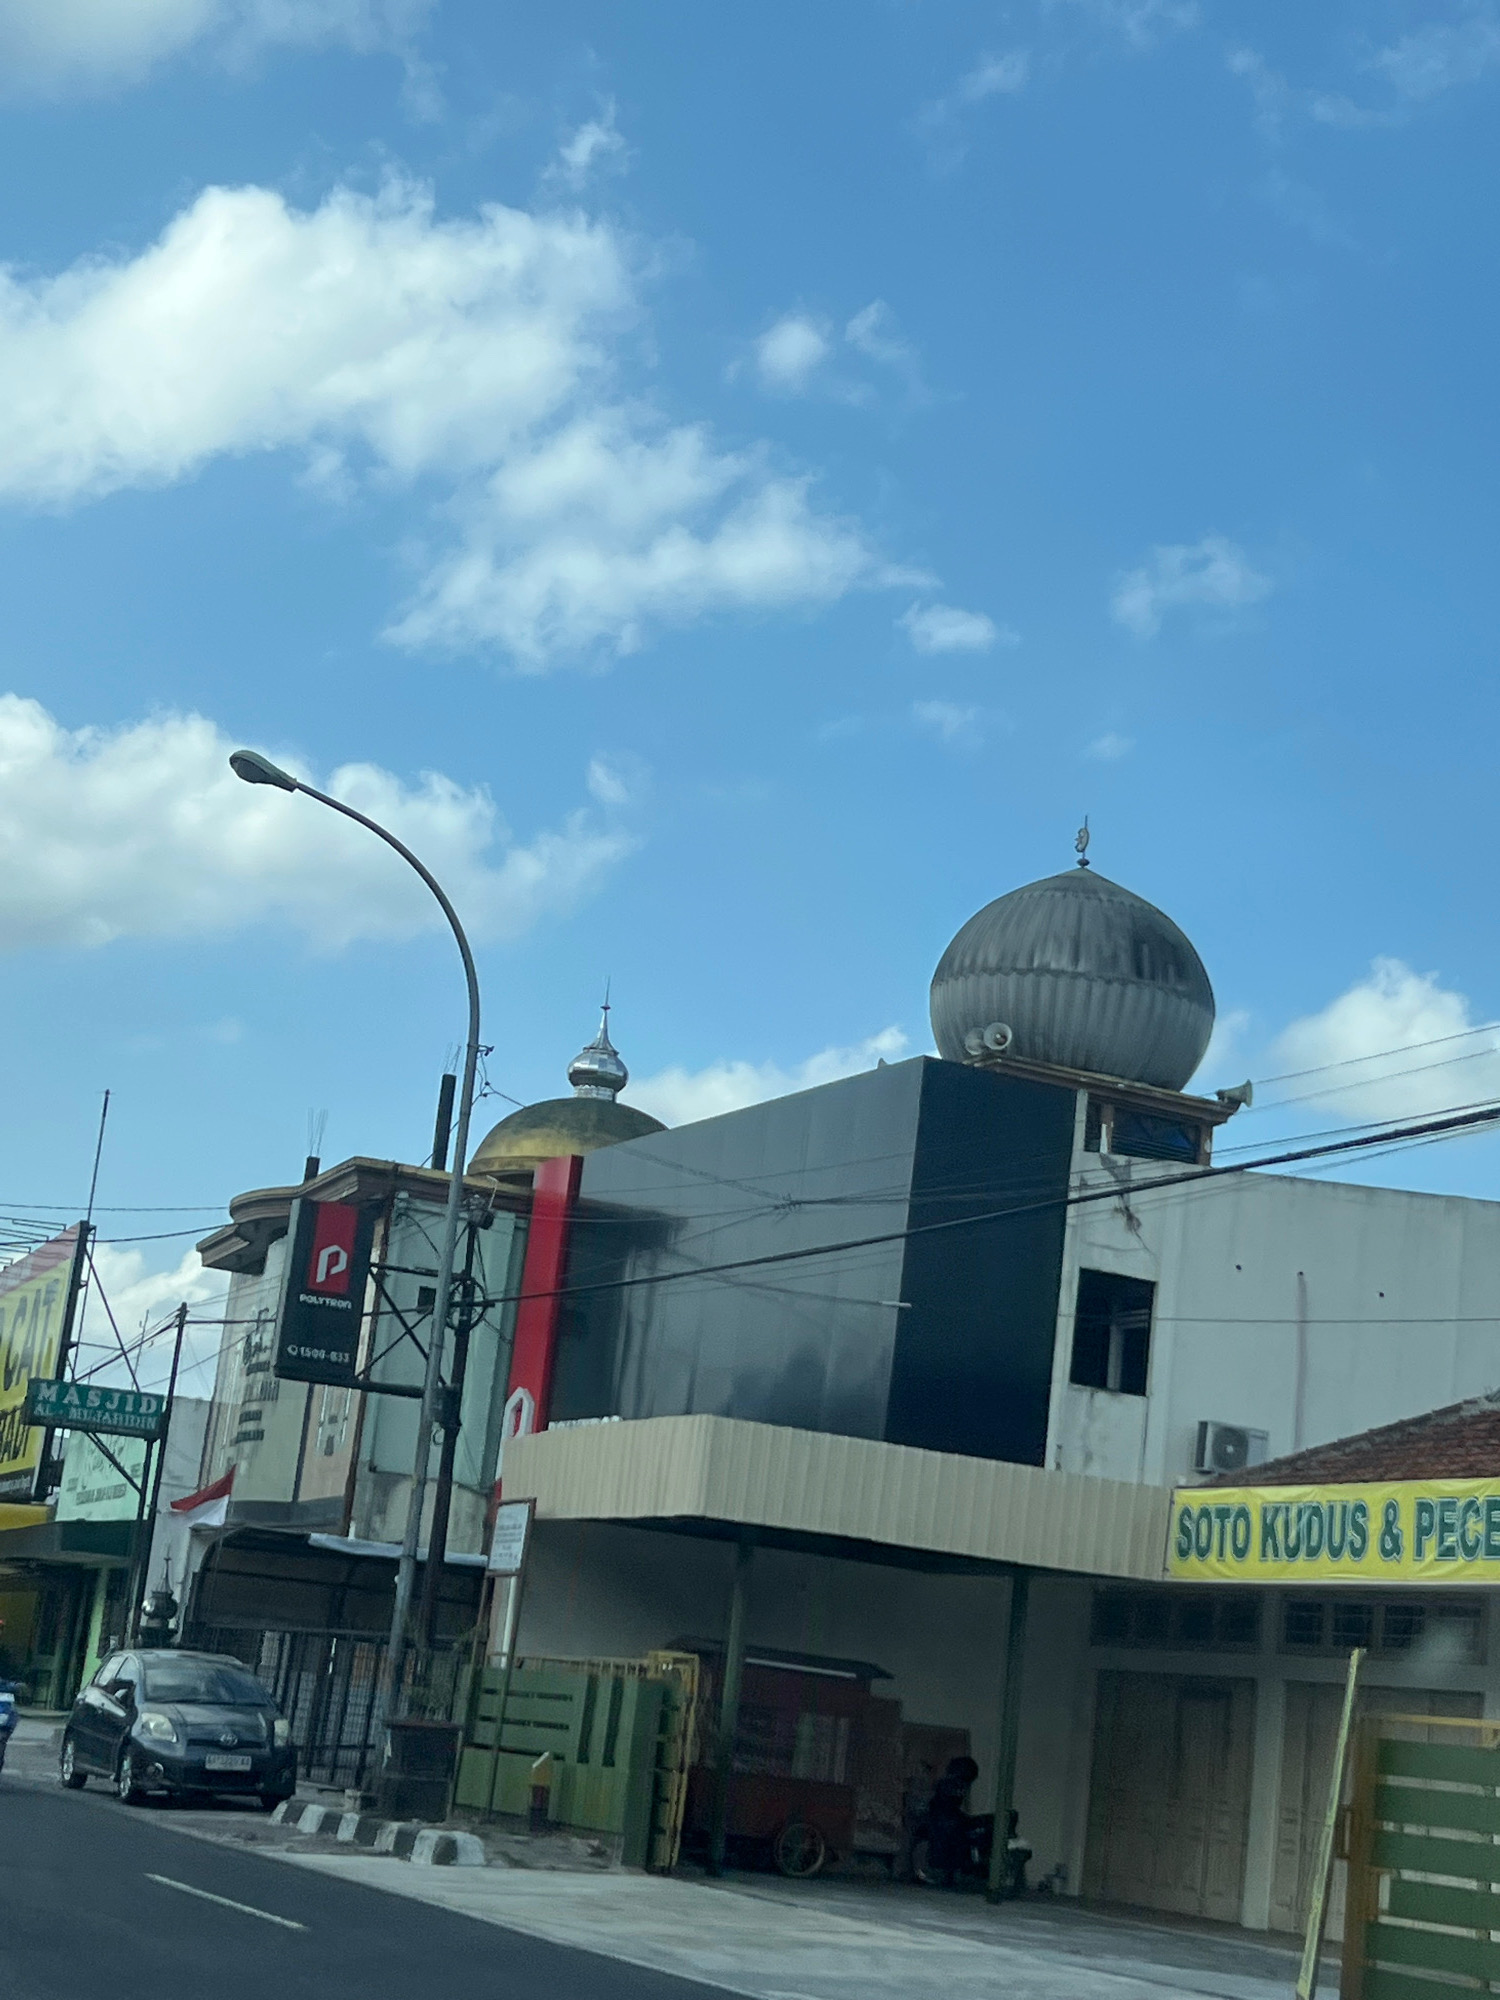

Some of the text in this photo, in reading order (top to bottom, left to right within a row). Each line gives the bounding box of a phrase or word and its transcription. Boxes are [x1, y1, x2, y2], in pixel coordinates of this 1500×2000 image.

[299, 1293, 352, 1310] POLYTRON
[37, 1382, 158, 1415] MASJID
[1175, 1495, 1500, 1563] SOTO KUDUS & PECE
